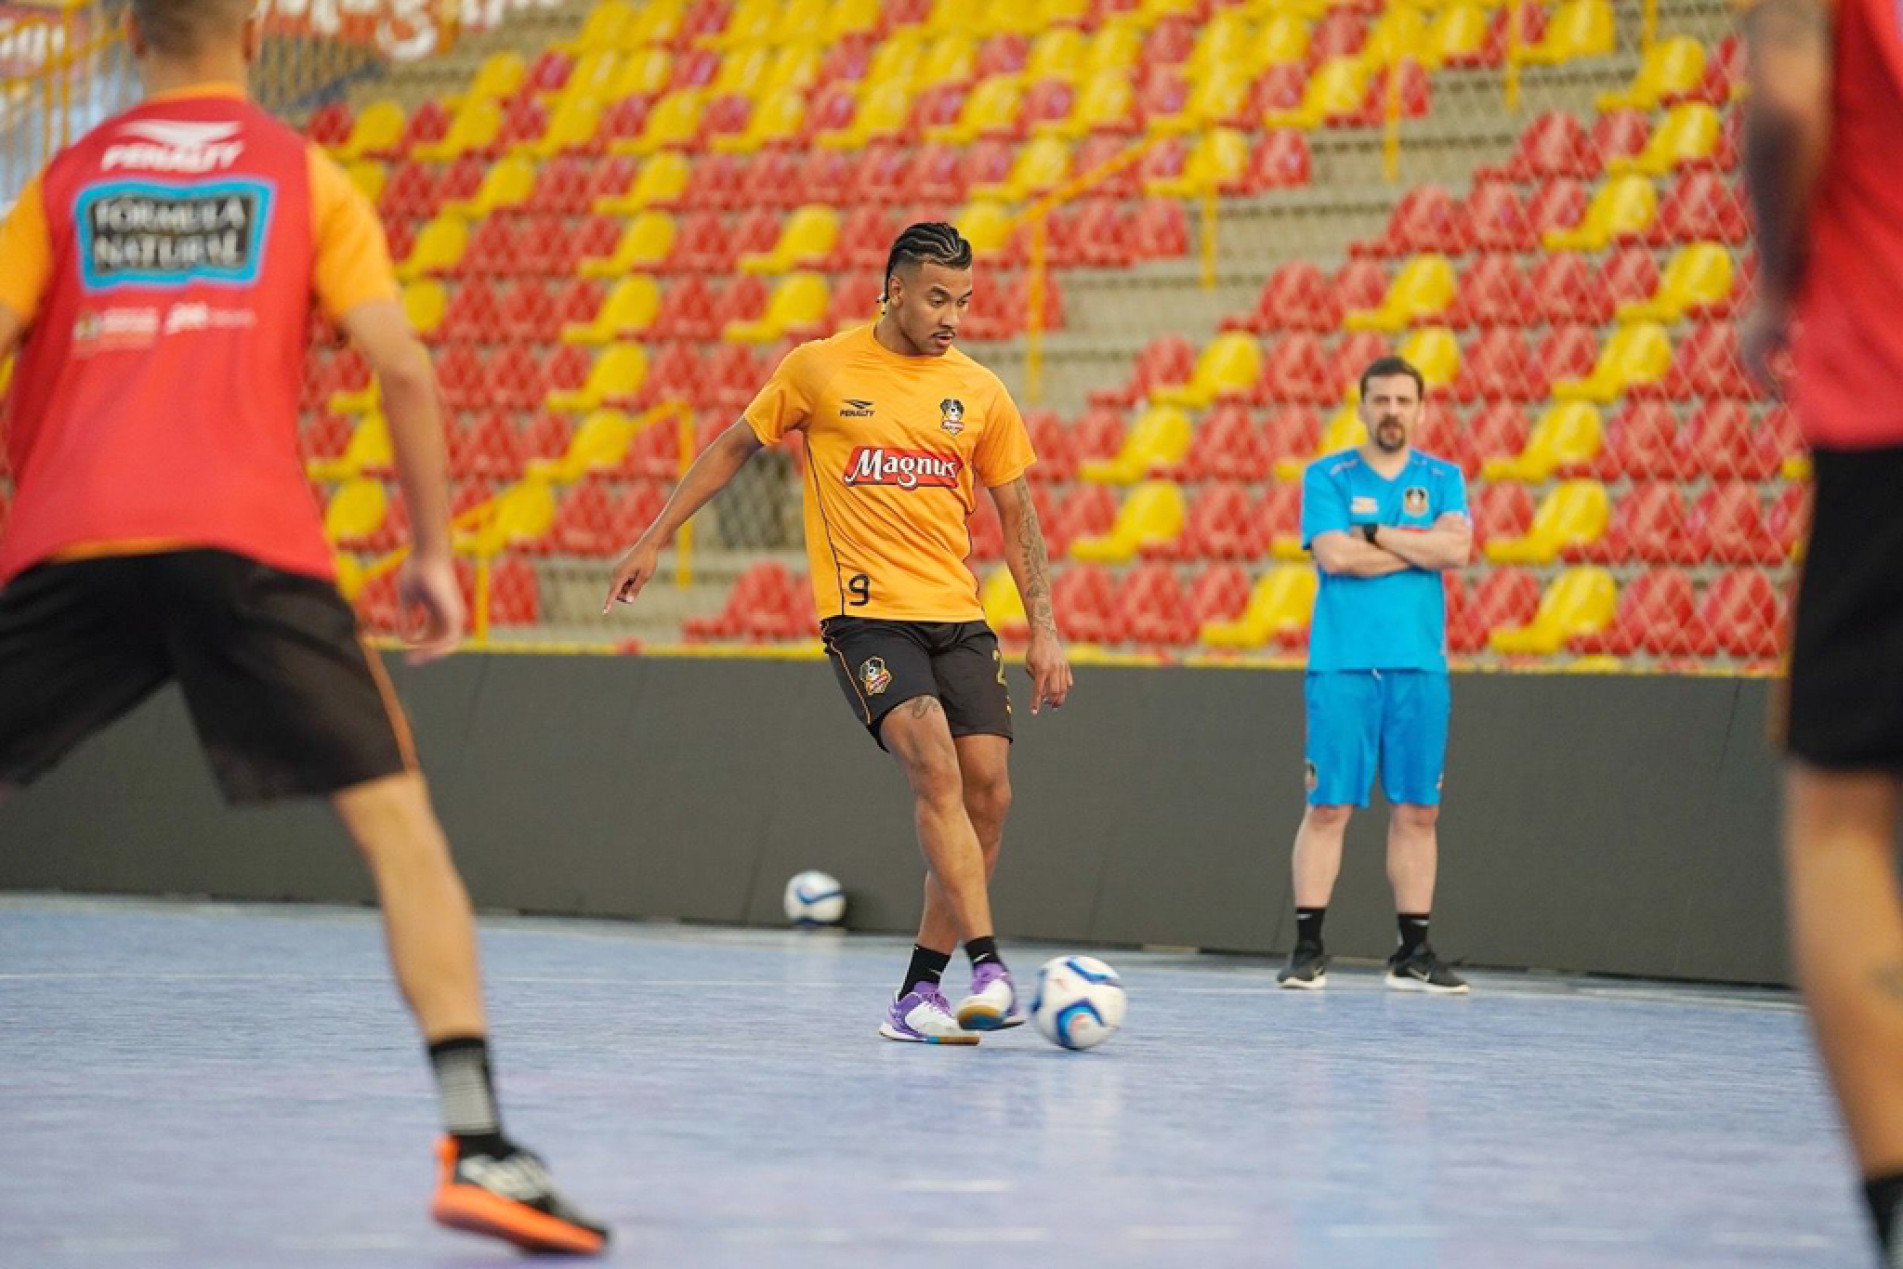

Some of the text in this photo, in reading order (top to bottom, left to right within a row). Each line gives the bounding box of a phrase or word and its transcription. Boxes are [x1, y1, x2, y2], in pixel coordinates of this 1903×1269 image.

[839, 409, 876, 417] PENALTY
[845, 448, 957, 487] Magnus
[848, 574, 870, 606] 9
